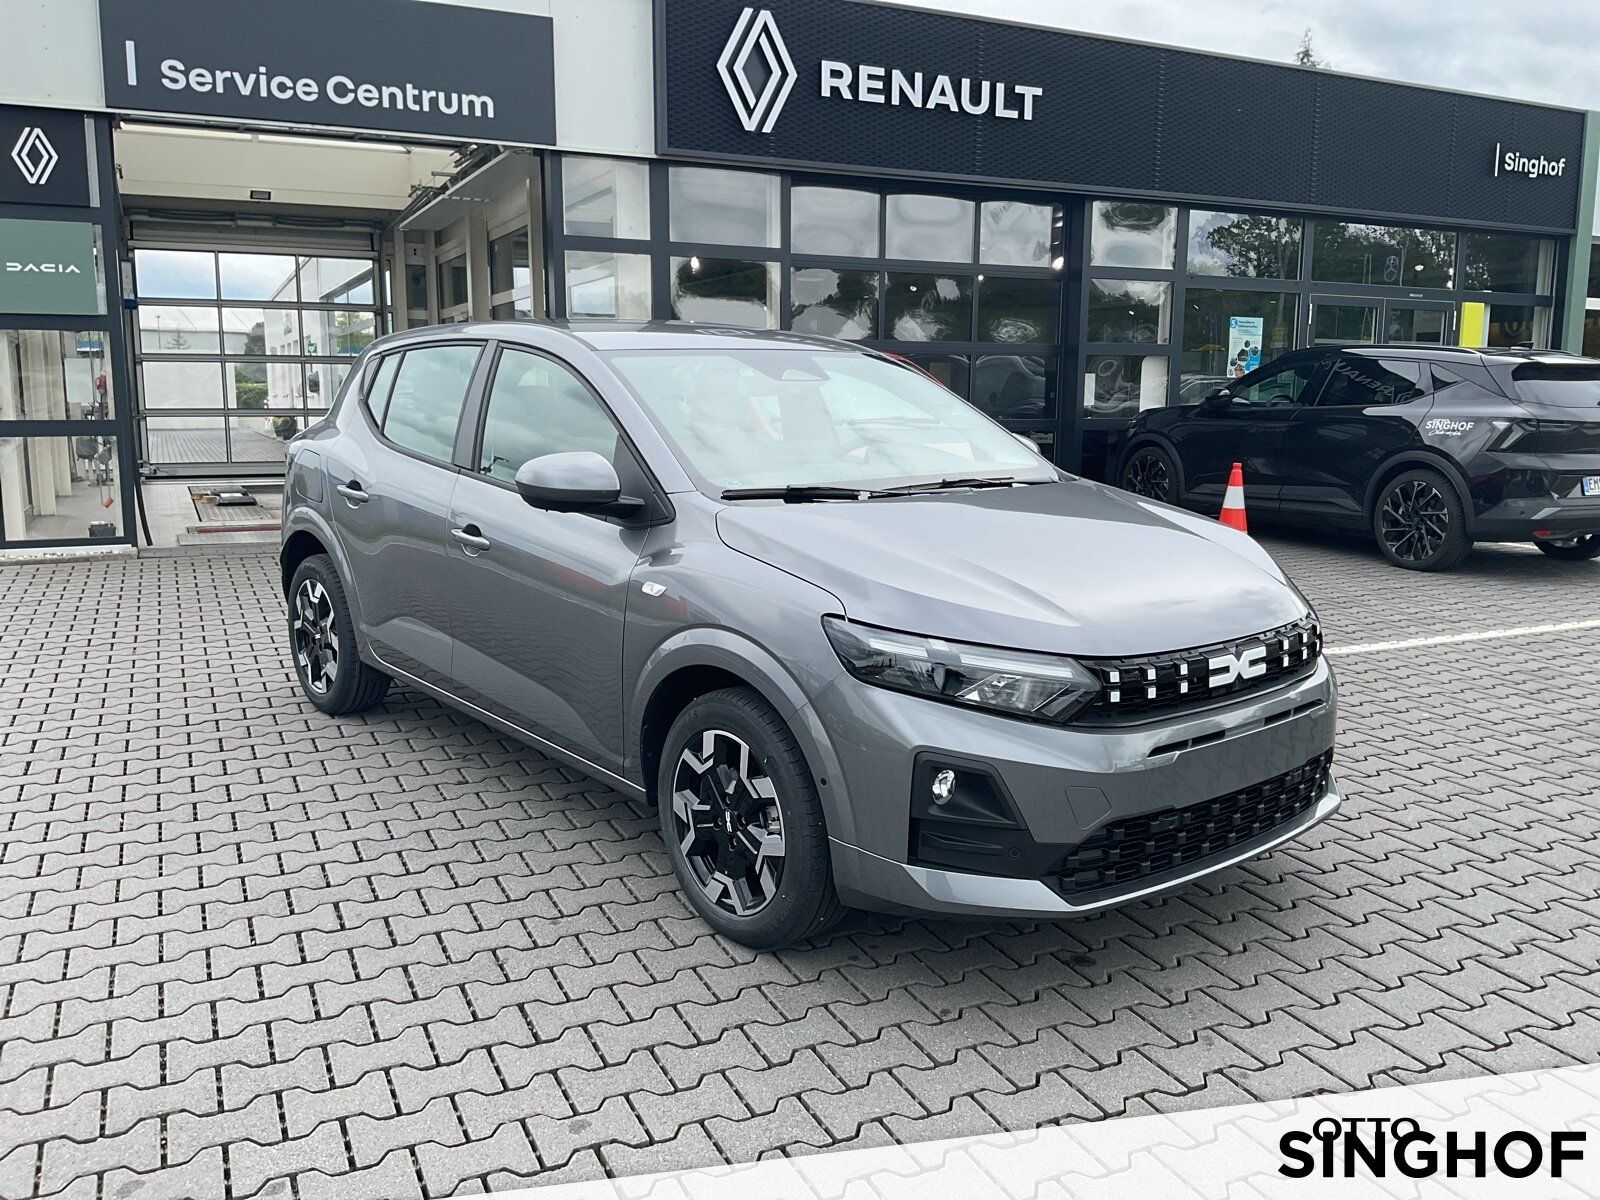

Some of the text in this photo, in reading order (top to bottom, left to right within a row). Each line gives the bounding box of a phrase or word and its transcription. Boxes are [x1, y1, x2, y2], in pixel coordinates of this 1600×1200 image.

[160, 58, 495, 119] Service Centrum
[820, 59, 1043, 121] RENAULT
[1504, 152, 1566, 178] Singhof
[5, 262, 81, 274] DACIA
[1425, 420, 1475, 431] SINGHOF
